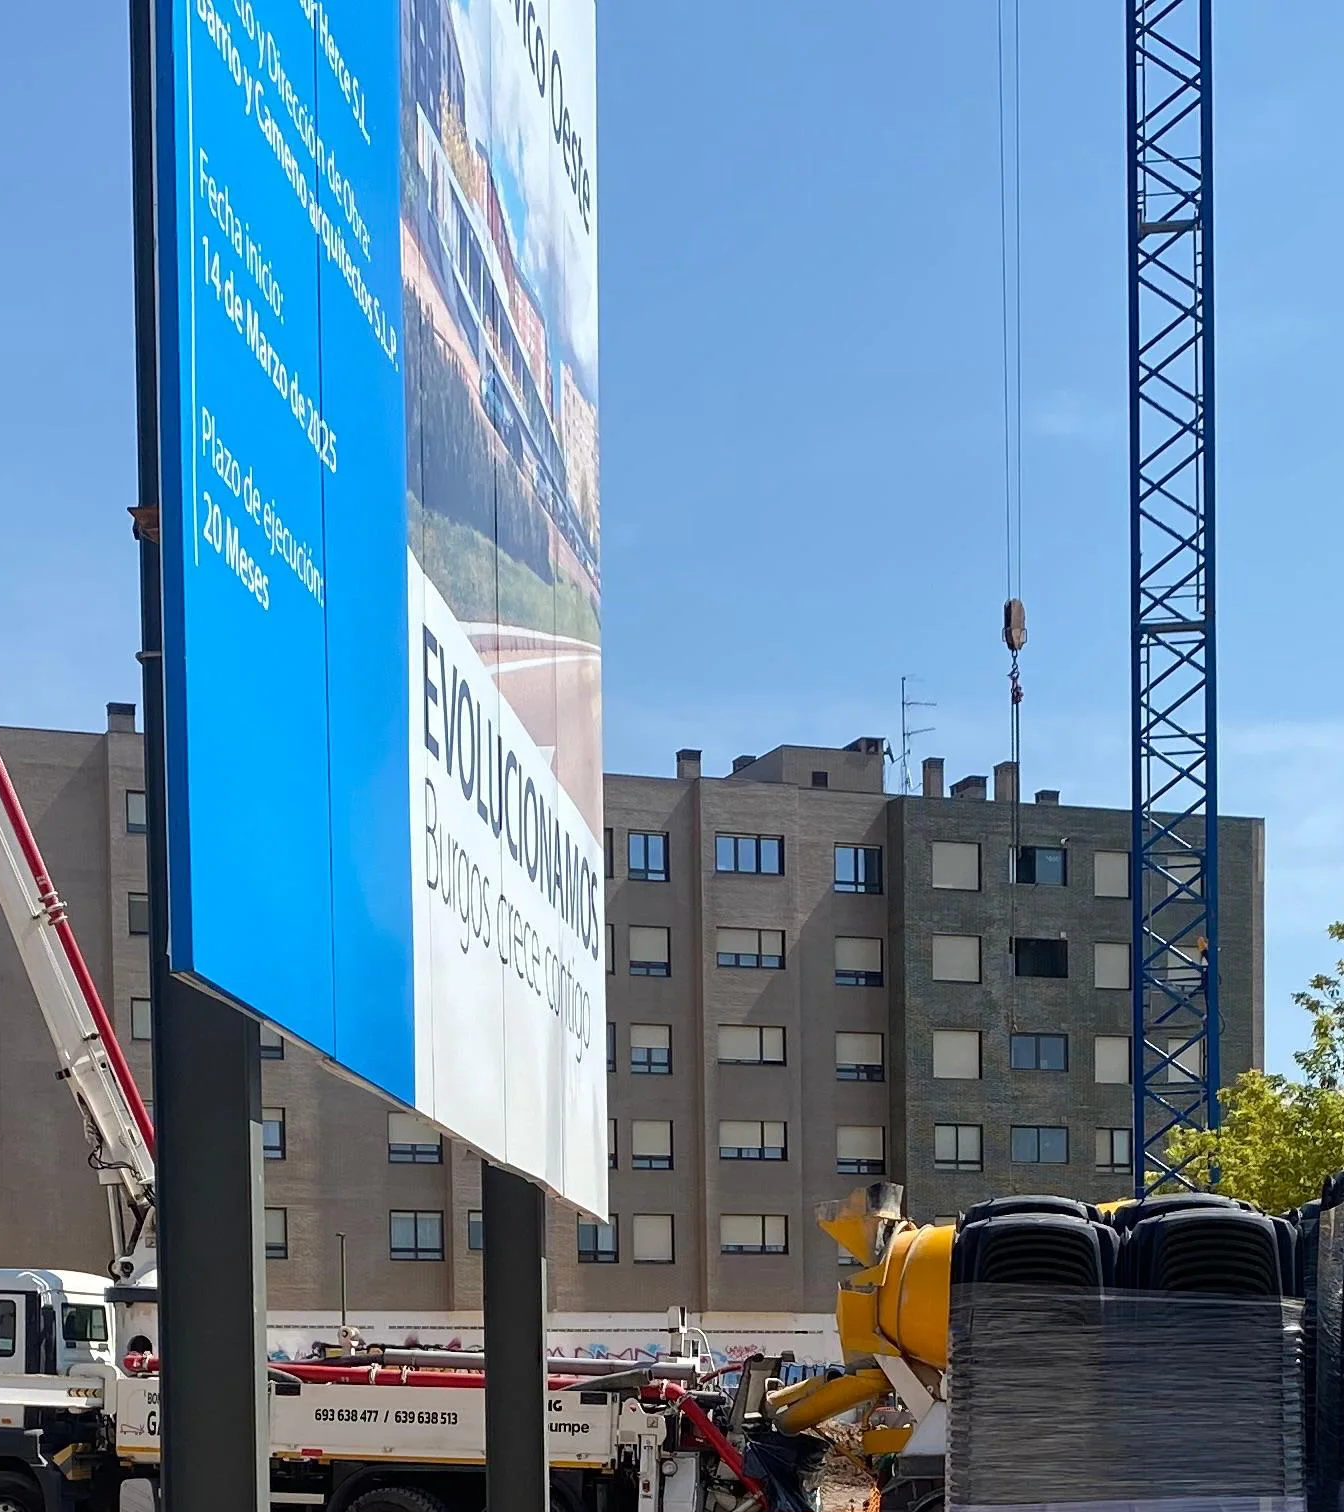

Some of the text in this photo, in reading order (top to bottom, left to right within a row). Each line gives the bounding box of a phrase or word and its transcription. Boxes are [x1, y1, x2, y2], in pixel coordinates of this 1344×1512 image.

[256, 20, 265, 69] y
[267, 31, 326, 176] Dirección
[327, 149, 343, 206] de
[343, 178, 372, 263] Obra:
[319, 1, 352, 104] Herce
[551, 49, 591, 235] Oeste
[199, 146, 285, 325] Fecha inicio:
[243, 65, 253, 115] y
[308, 190, 374, 325] arquitectos
[202, 234, 338, 474] 14 de Marzo de 2025
[201, 405, 325, 609] Plazo de ejecución:
[203, 490, 270, 611] 20 Meses
[422, 621, 599, 963] EVOLUCIONAMOS
[425, 777, 591, 1064] Burgos crece contigo
[314, 1408, 335, 1422] 693
[337, 1408, 358, 1423] 638
[359, 1409, 379, 1423] 477
[394, 1410, 416, 1424] 639
[417, 1411, 439, 1425] 638
[440, 1411, 458, 1425] 513
